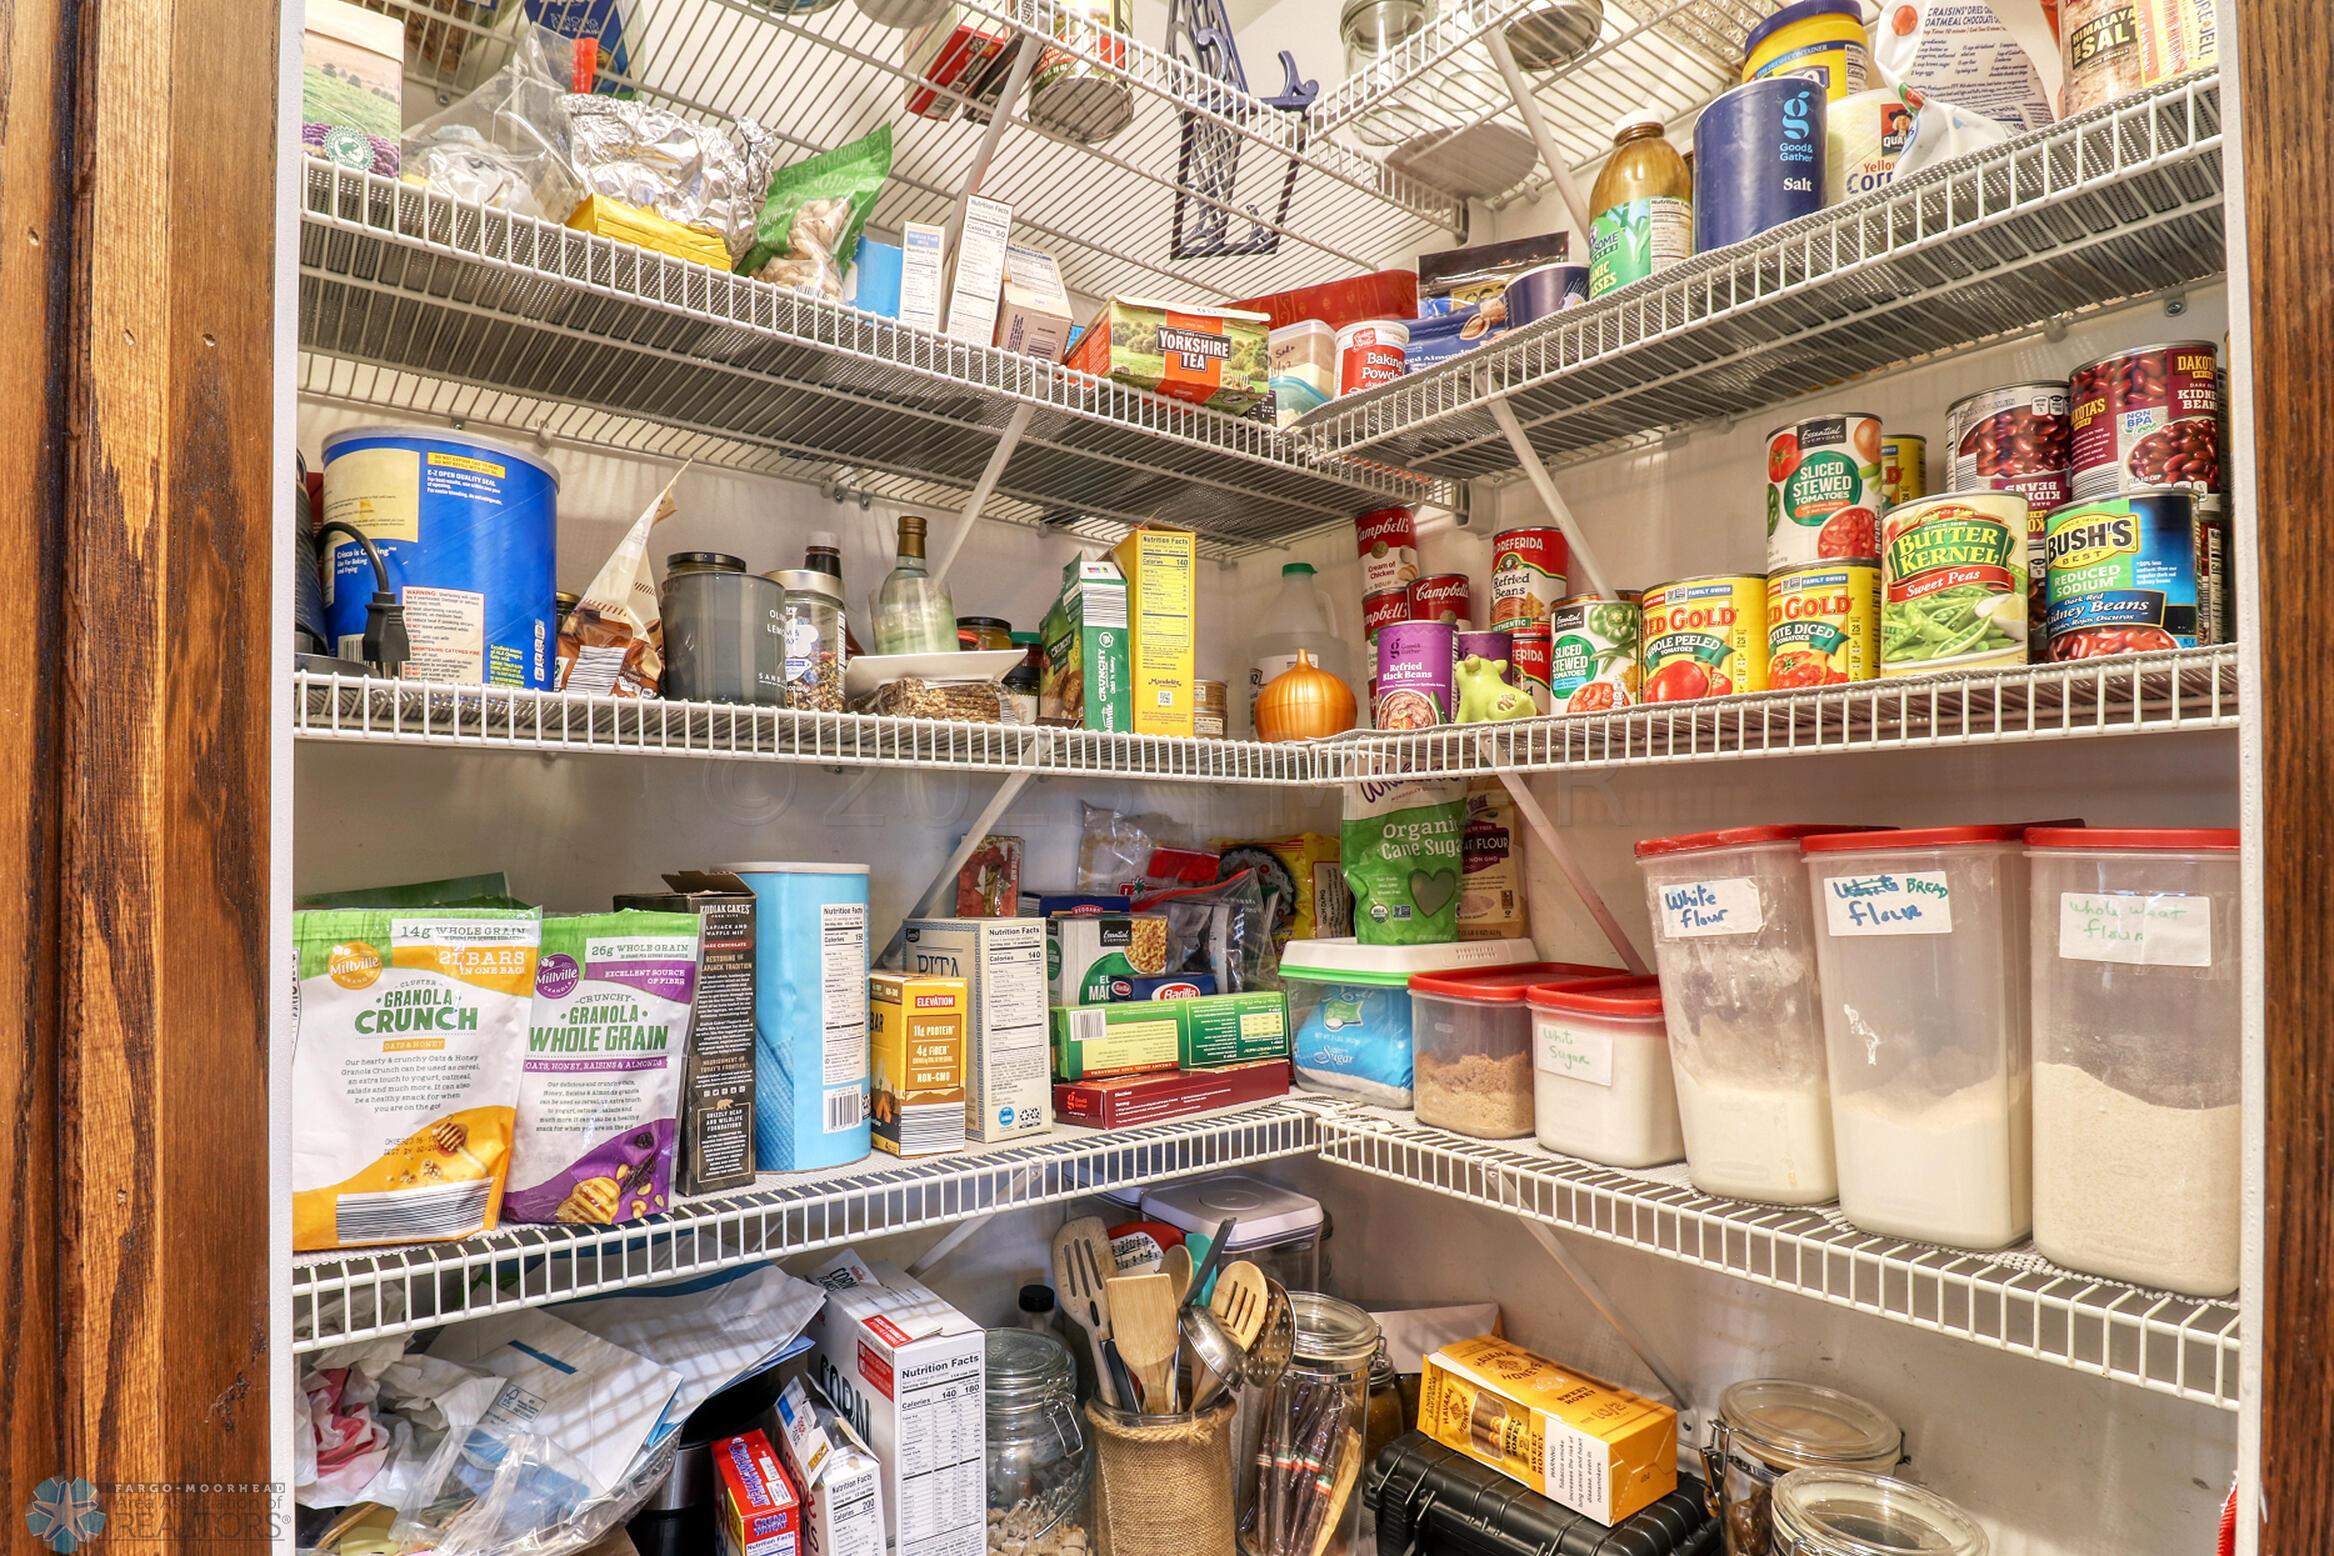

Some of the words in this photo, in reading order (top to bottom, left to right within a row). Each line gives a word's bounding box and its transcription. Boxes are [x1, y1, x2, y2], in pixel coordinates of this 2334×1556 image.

[1779, 151, 1814, 163] Gather
[1783, 176, 1813, 193] Salt
[1158, 328, 1230, 359] YORKSHIRE
[1182, 351, 1206, 370] TEA
[2127, 409, 2151, 420] NON
[2127, 416, 2153, 428] BPA
[1800, 461, 1844, 481] SLICED
[1792, 475, 1853, 498] STEWED
[1795, 490, 1850, 506] TOMATOES
[1142, 534, 1170, 545] Nutrition
[1171, 536, 1189, 546] Facts
[1898, 525, 1999, 557] BUTTER
[2047, 519, 2133, 564] BUSH'S
[1142, 557, 1165, 566] Calories
[1176, 558, 1189, 567] 140
[1899, 546, 2000, 577] KERNEL
[2061, 550, 2102, 566] BEST
[1369, 568, 1395, 580] Chicken
[1803, 576, 1825, 586] FAMILY
[2054, 564, 2121, 588] REDUCED
[1688, 587, 1709, 596] FAMILY
[1905, 576, 1945, 599] Sweet
[1947, 568, 1981, 588] Peas
[2056, 575, 2118, 598] SODIUM
[1495, 586, 1526, 600] Beans
[2064, 595, 2083, 606] Dark
[2086, 593, 2104, 602] Red
[1669, 606, 1737, 632] GOLD
[2047, 604, 2085, 625] idney
[2090, 600, 2149, 613] Beans
[1674, 634, 1721, 651] PEELED
[1776, 634, 1810, 645] TOMATOES
[1554, 643, 1583, 657] SLICED
[1660, 645, 1694, 656] TOMATOES
[1389, 662, 1423, 673] Refried
[1552, 654, 1589, 674] STEWED
[1383, 672, 1404, 682] Black
[1404, 670, 1433, 681] Beans
[1476, 836, 1509, 850] FLOUR
[1380, 843, 1421, 861] Cane
[1664, 884, 1717, 911] White
[726, 904, 750, 915] CAKES
[823, 906, 851, 916] Nutrition
[851, 906, 864, 915] Facts
[1849, 900, 1921, 927] flour
[1681, 907, 1729, 929] flour
[401, 926, 432, 940] 14g
[436, 926, 481, 936] WHOLE
[484, 926, 526, 936] GRAIN
[824, 935, 845, 944] Calories
[989, 926, 1021, 937] Nutrition
[1021, 926, 1040, 936] Facts
[591, 945, 614, 957] 26g
[616, 944, 654, 952] WHOLE
[655, 944, 689, 952] GRAIN
[989, 954, 1015, 963] Calories
[1027, 951, 1041, 960] 140
[466, 951, 526, 967] BARS
[329, 957, 381, 978] Millville
[474, 967, 499, 975] ONE
[604, 969, 651, 978] EXCELLENT
[651, 969, 685, 977] SOURCE
[536, 967, 578, 986] Millville
[647, 977, 658, 985] OF
[658, 977, 686, 985] FIBER
[384, 988, 453, 1009] GRANOLA
[579, 993, 632, 1005] CRUNCHY
[354, 1006, 479, 1036] CRUNCH
[569, 1004, 638, 1025] GRANOLA
[870, 1012, 885, 1035] BAR
[529, 1025, 601, 1053] WHOLE
[604, 1024, 669, 1052] GRAIN
[1313, 1044, 1354, 1066] Sugar
[901, 1361, 948, 1380] Nutrition
[950, 1354, 980, 1369] Facts
[941, 1389, 957, 1400] 140
[964, 1384, 980, 1395] 180
[1556, 1385, 1589, 1402] SWEET
[901, 1397, 931, 1410] Calories
[1442, 1387, 1454, 1425] HAVANA
[1505, 1416, 1516, 1456] SWEET
[831, 1478, 857, 1495] Nutrition
[857, 1473, 873, 1486] Facts
[862, 1499, 875, 1511] 200
[833, 1509, 855, 1522] Calories
[746, 1537, 776, 1551] Nutrition
[776, 1532, 794, 1544] Facts
